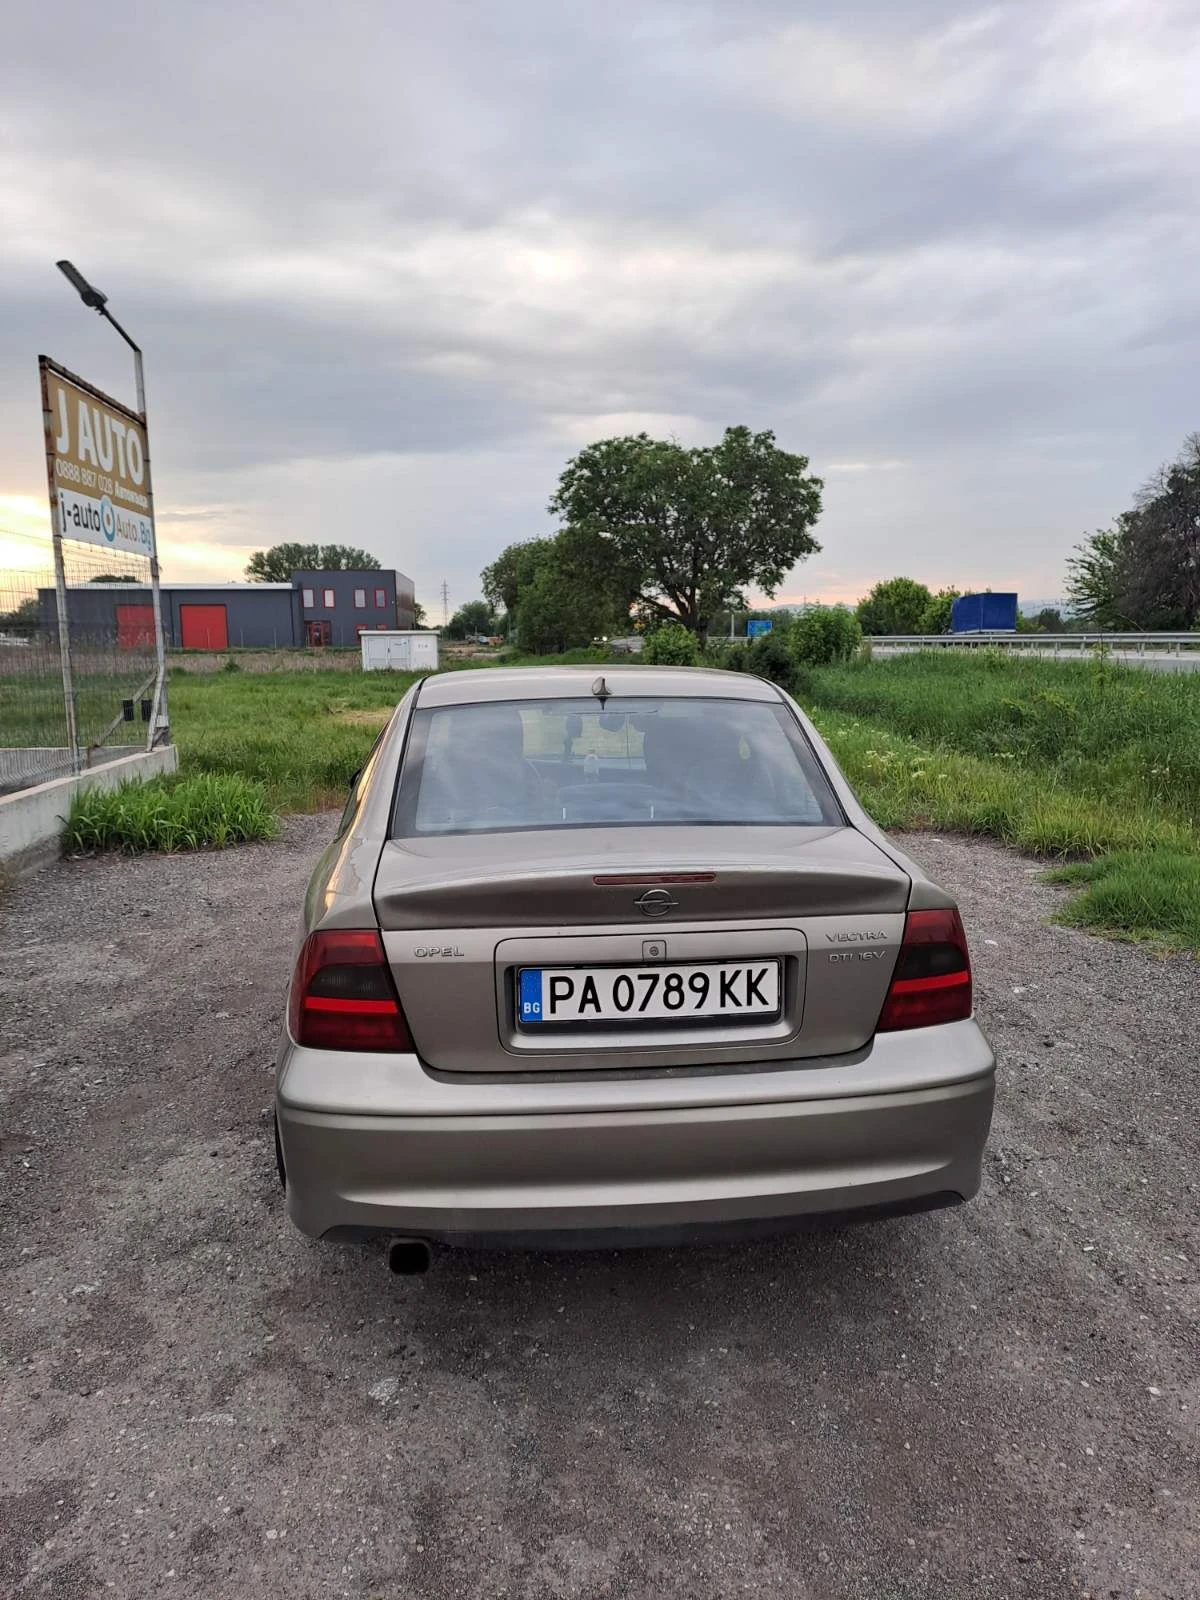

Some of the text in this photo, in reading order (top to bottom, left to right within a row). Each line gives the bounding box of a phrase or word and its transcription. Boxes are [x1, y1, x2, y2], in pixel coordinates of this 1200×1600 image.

[56, 388, 144, 486] J AUTO
[60, 492, 101, 533] j-auto
[825, 929, 889, 943] VECTRA
[414, 947, 465, 959] OPEL
[858, 950, 887, 961] 16V
[523, 1002, 541, 1014] BG
